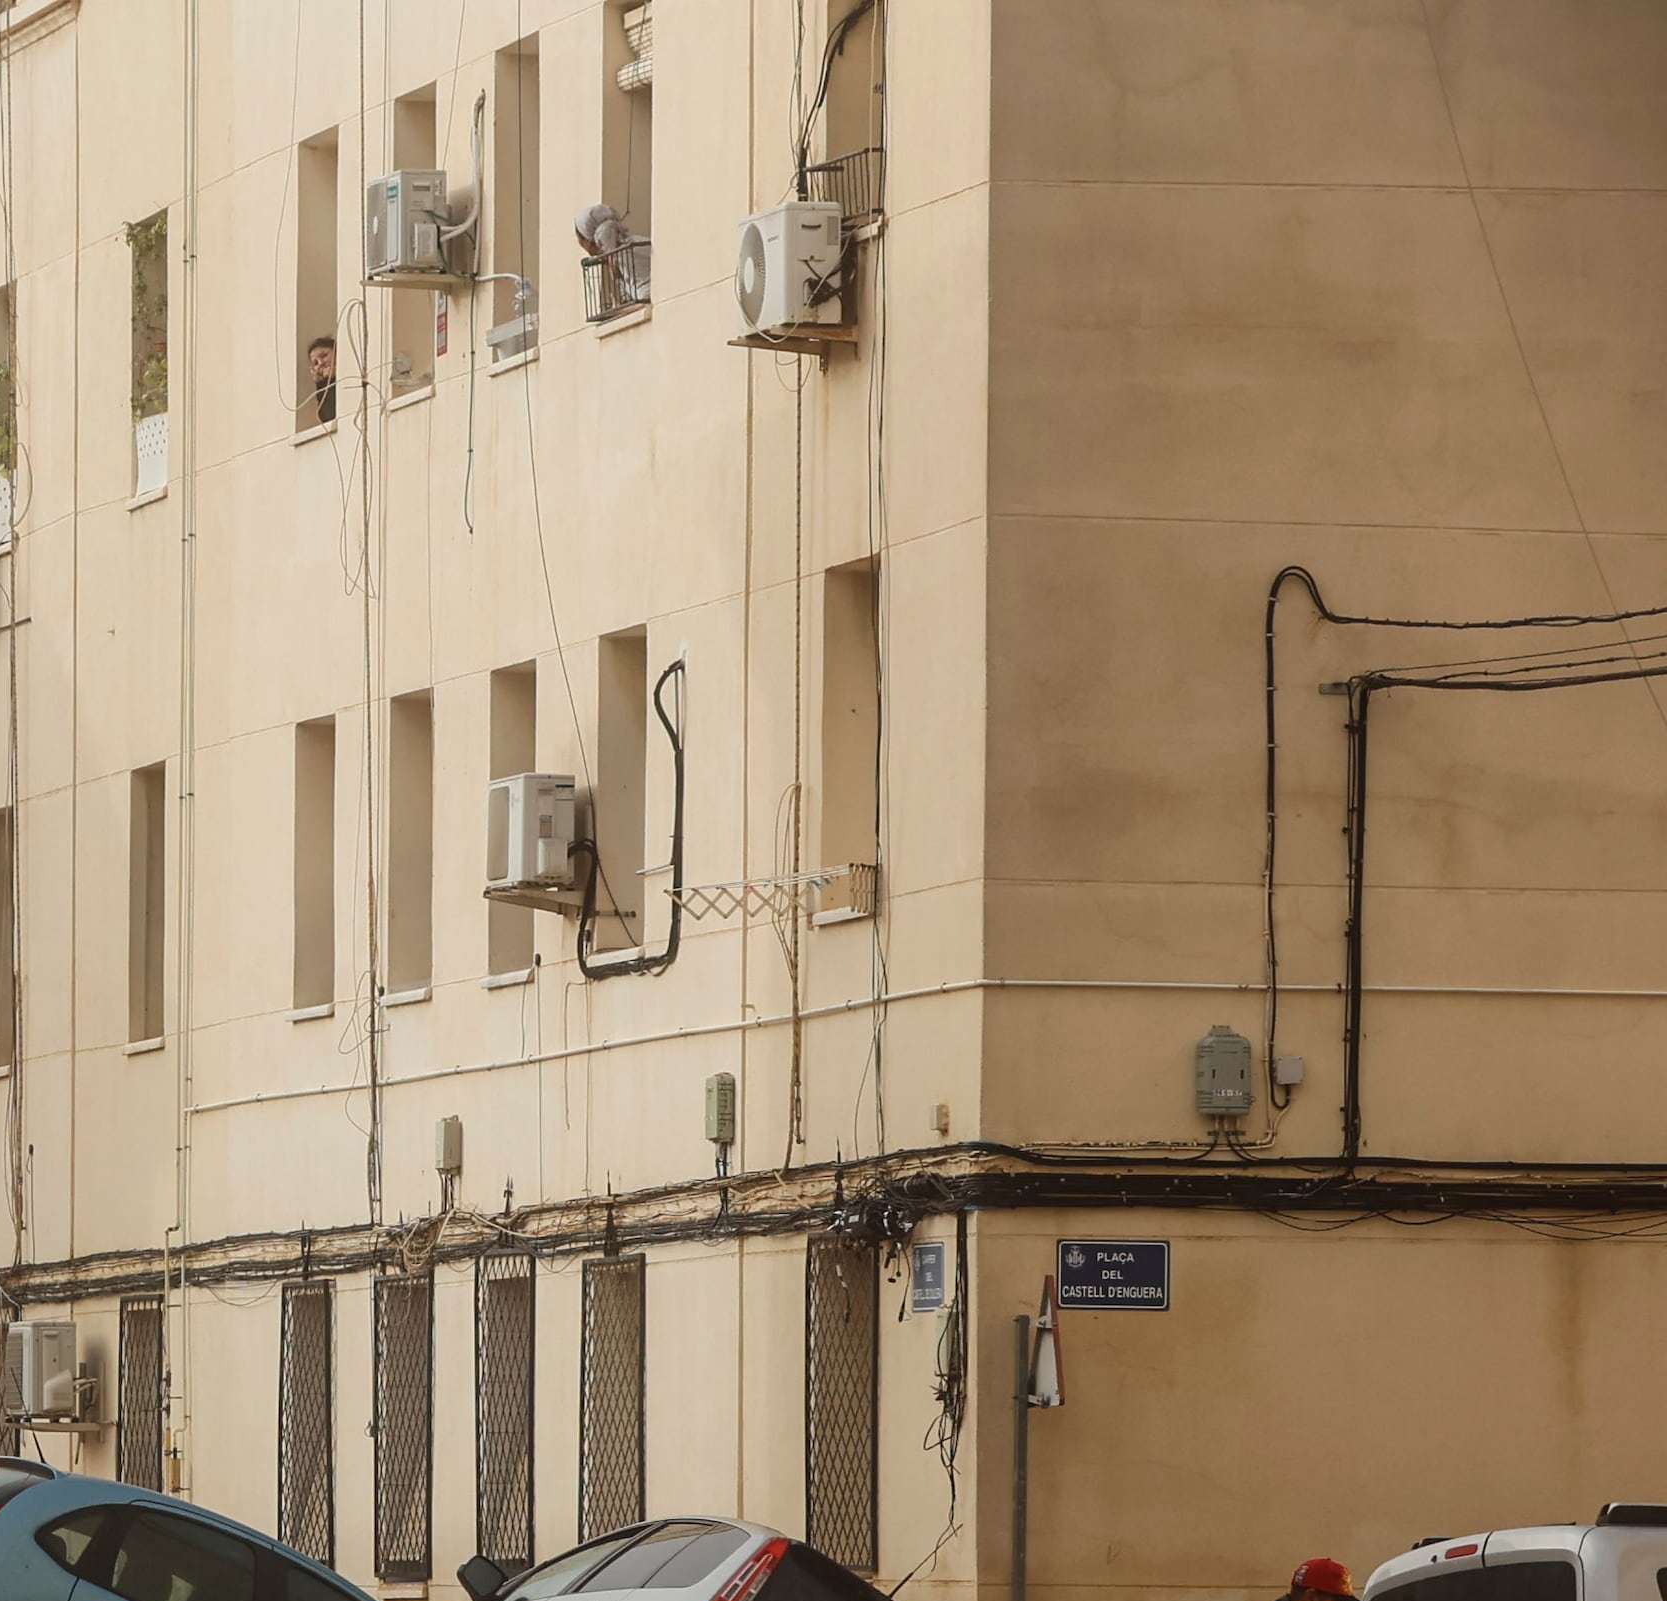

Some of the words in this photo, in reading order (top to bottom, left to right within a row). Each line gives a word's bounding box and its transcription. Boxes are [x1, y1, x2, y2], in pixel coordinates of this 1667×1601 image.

[1096, 1252, 1135, 1265] PLAÇA
[1101, 1269, 1124, 1280] DEL
[1062, 1285, 1106, 1298] CASTELL
[1107, 1286, 1163, 1299] D'ENGUERA
